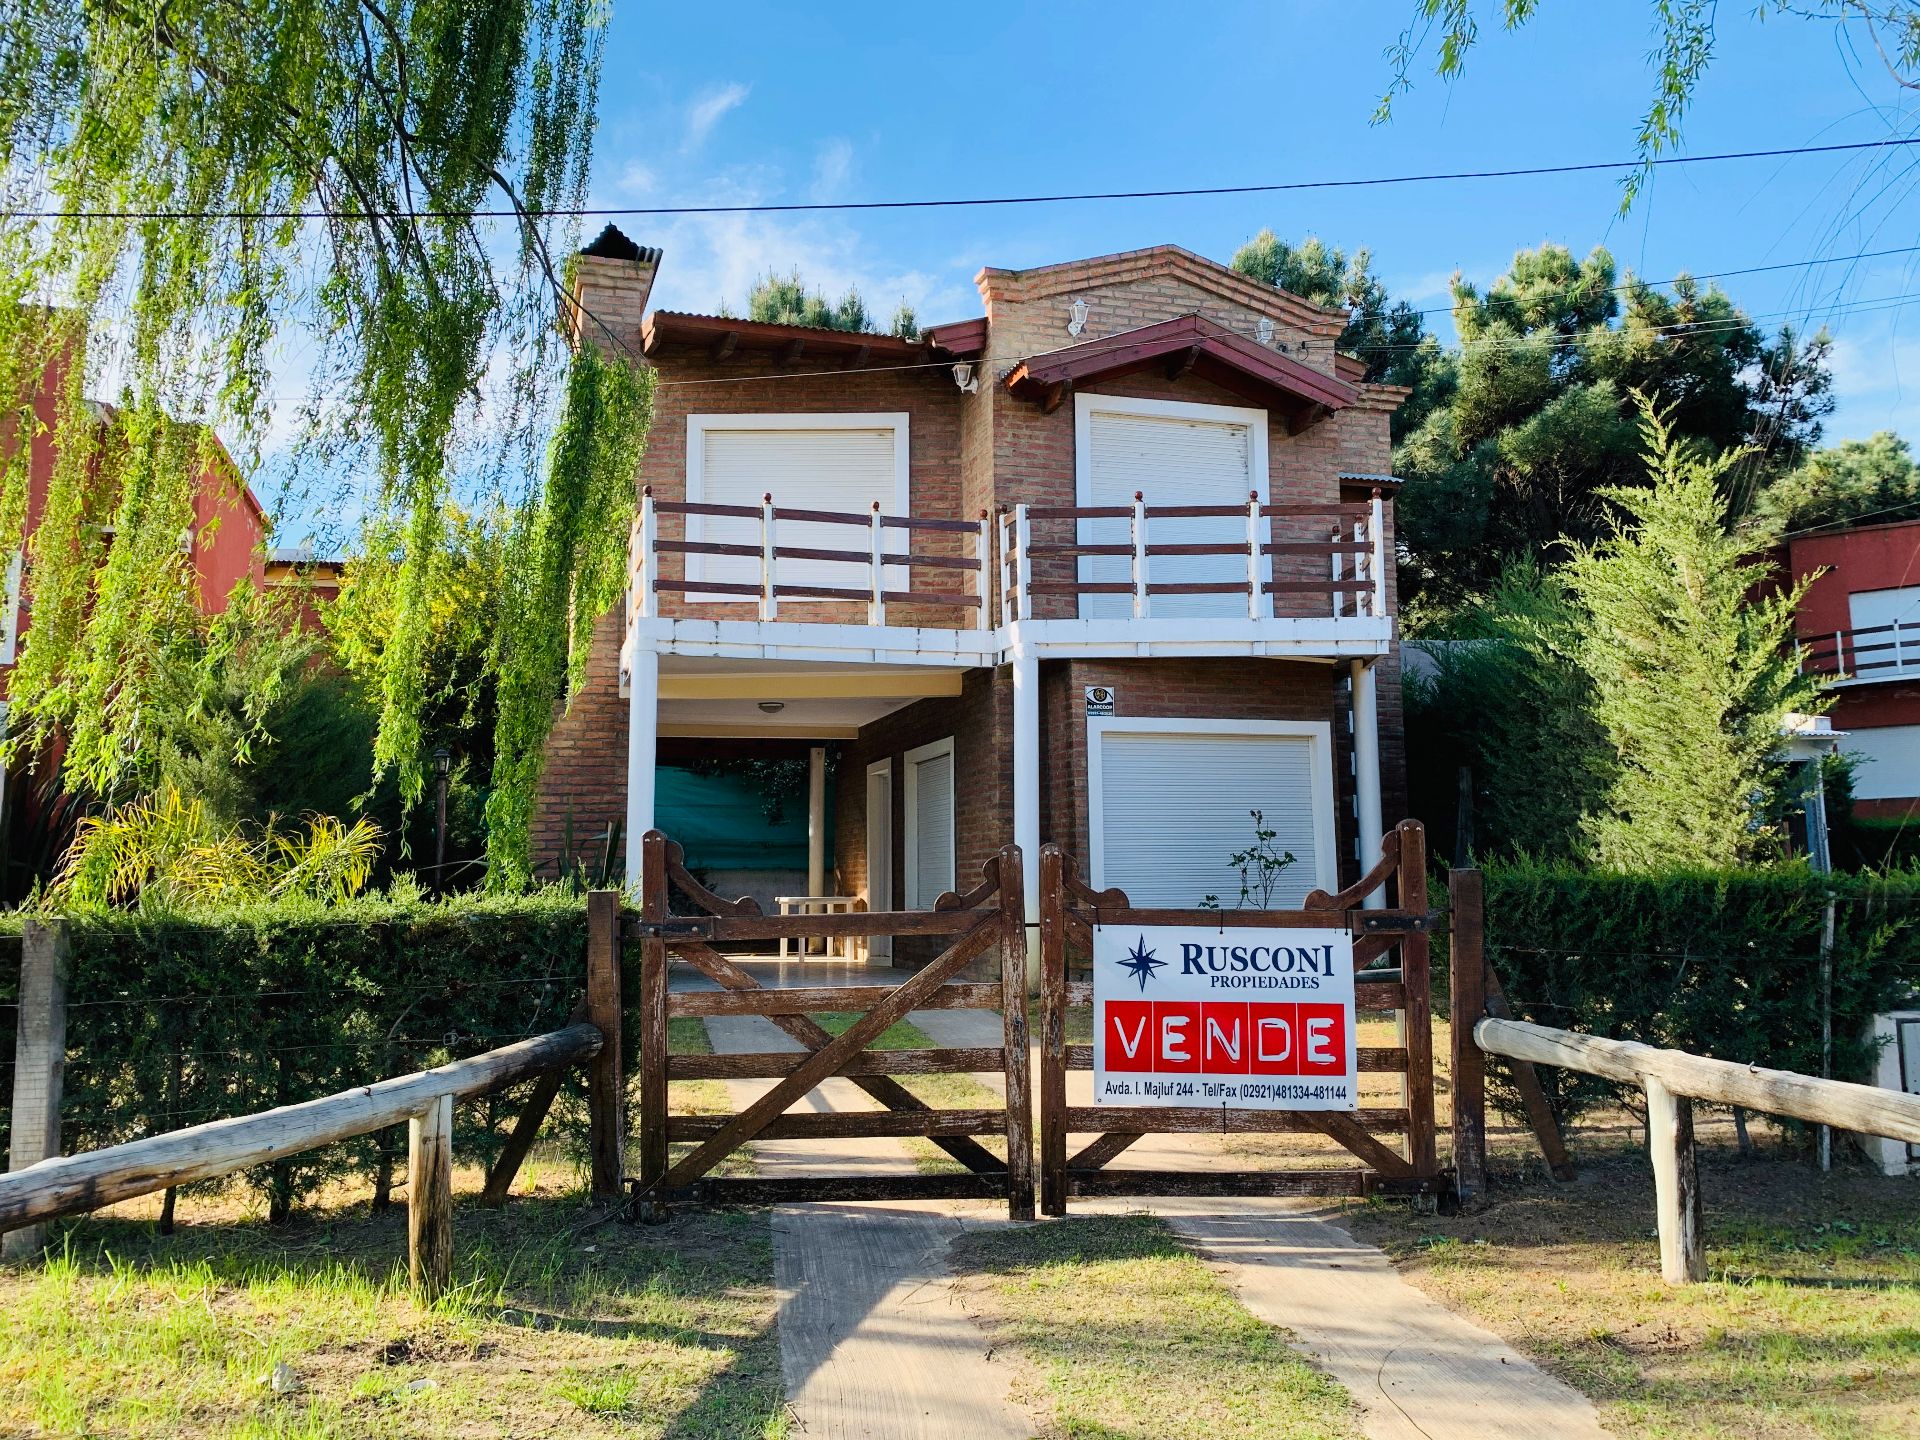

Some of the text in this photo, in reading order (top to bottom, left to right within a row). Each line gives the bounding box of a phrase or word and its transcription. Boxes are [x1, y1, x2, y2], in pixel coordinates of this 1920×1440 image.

[1180, 943, 1335, 977] RUSCONI
[1210, 975, 1320, 989] PROPIEDADES
[1113, 1015, 1337, 1065] VENDE
[1105, 1080, 1132, 1095] Avda.
[1135, 1081, 1141, 1095] I.
[1144, 1081, 1174, 1099] Majluf
[1176, 1082, 1193, 1096] 244
[1202, 1082, 1237, 1098] Tel/Fax
